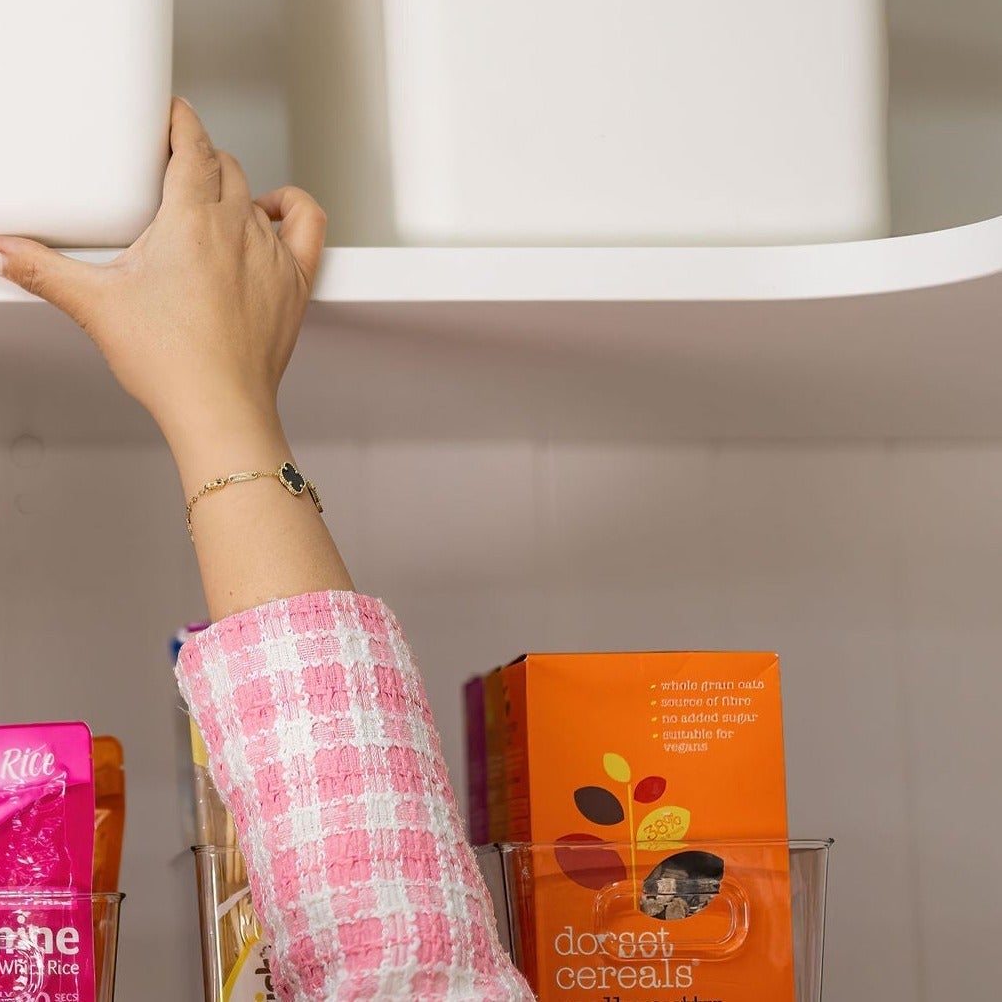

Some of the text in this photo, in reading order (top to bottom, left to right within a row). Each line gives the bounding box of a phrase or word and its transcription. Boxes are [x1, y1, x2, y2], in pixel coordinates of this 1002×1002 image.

[661, 680, 765, 691] whole grain oats
[661, 696, 751, 707] source of fibre
[662, 713, 759, 724] no added sugar
[663, 729, 735, 740] suitable for
[663, 743, 709, 754] vegans
[0, 746, 57, 781] Rice
[643, 813, 682, 841] 38%
[554, 926, 674, 958] dorset
[47, 960, 80, 975] Rice
[556, 959, 693, 990] cereals
